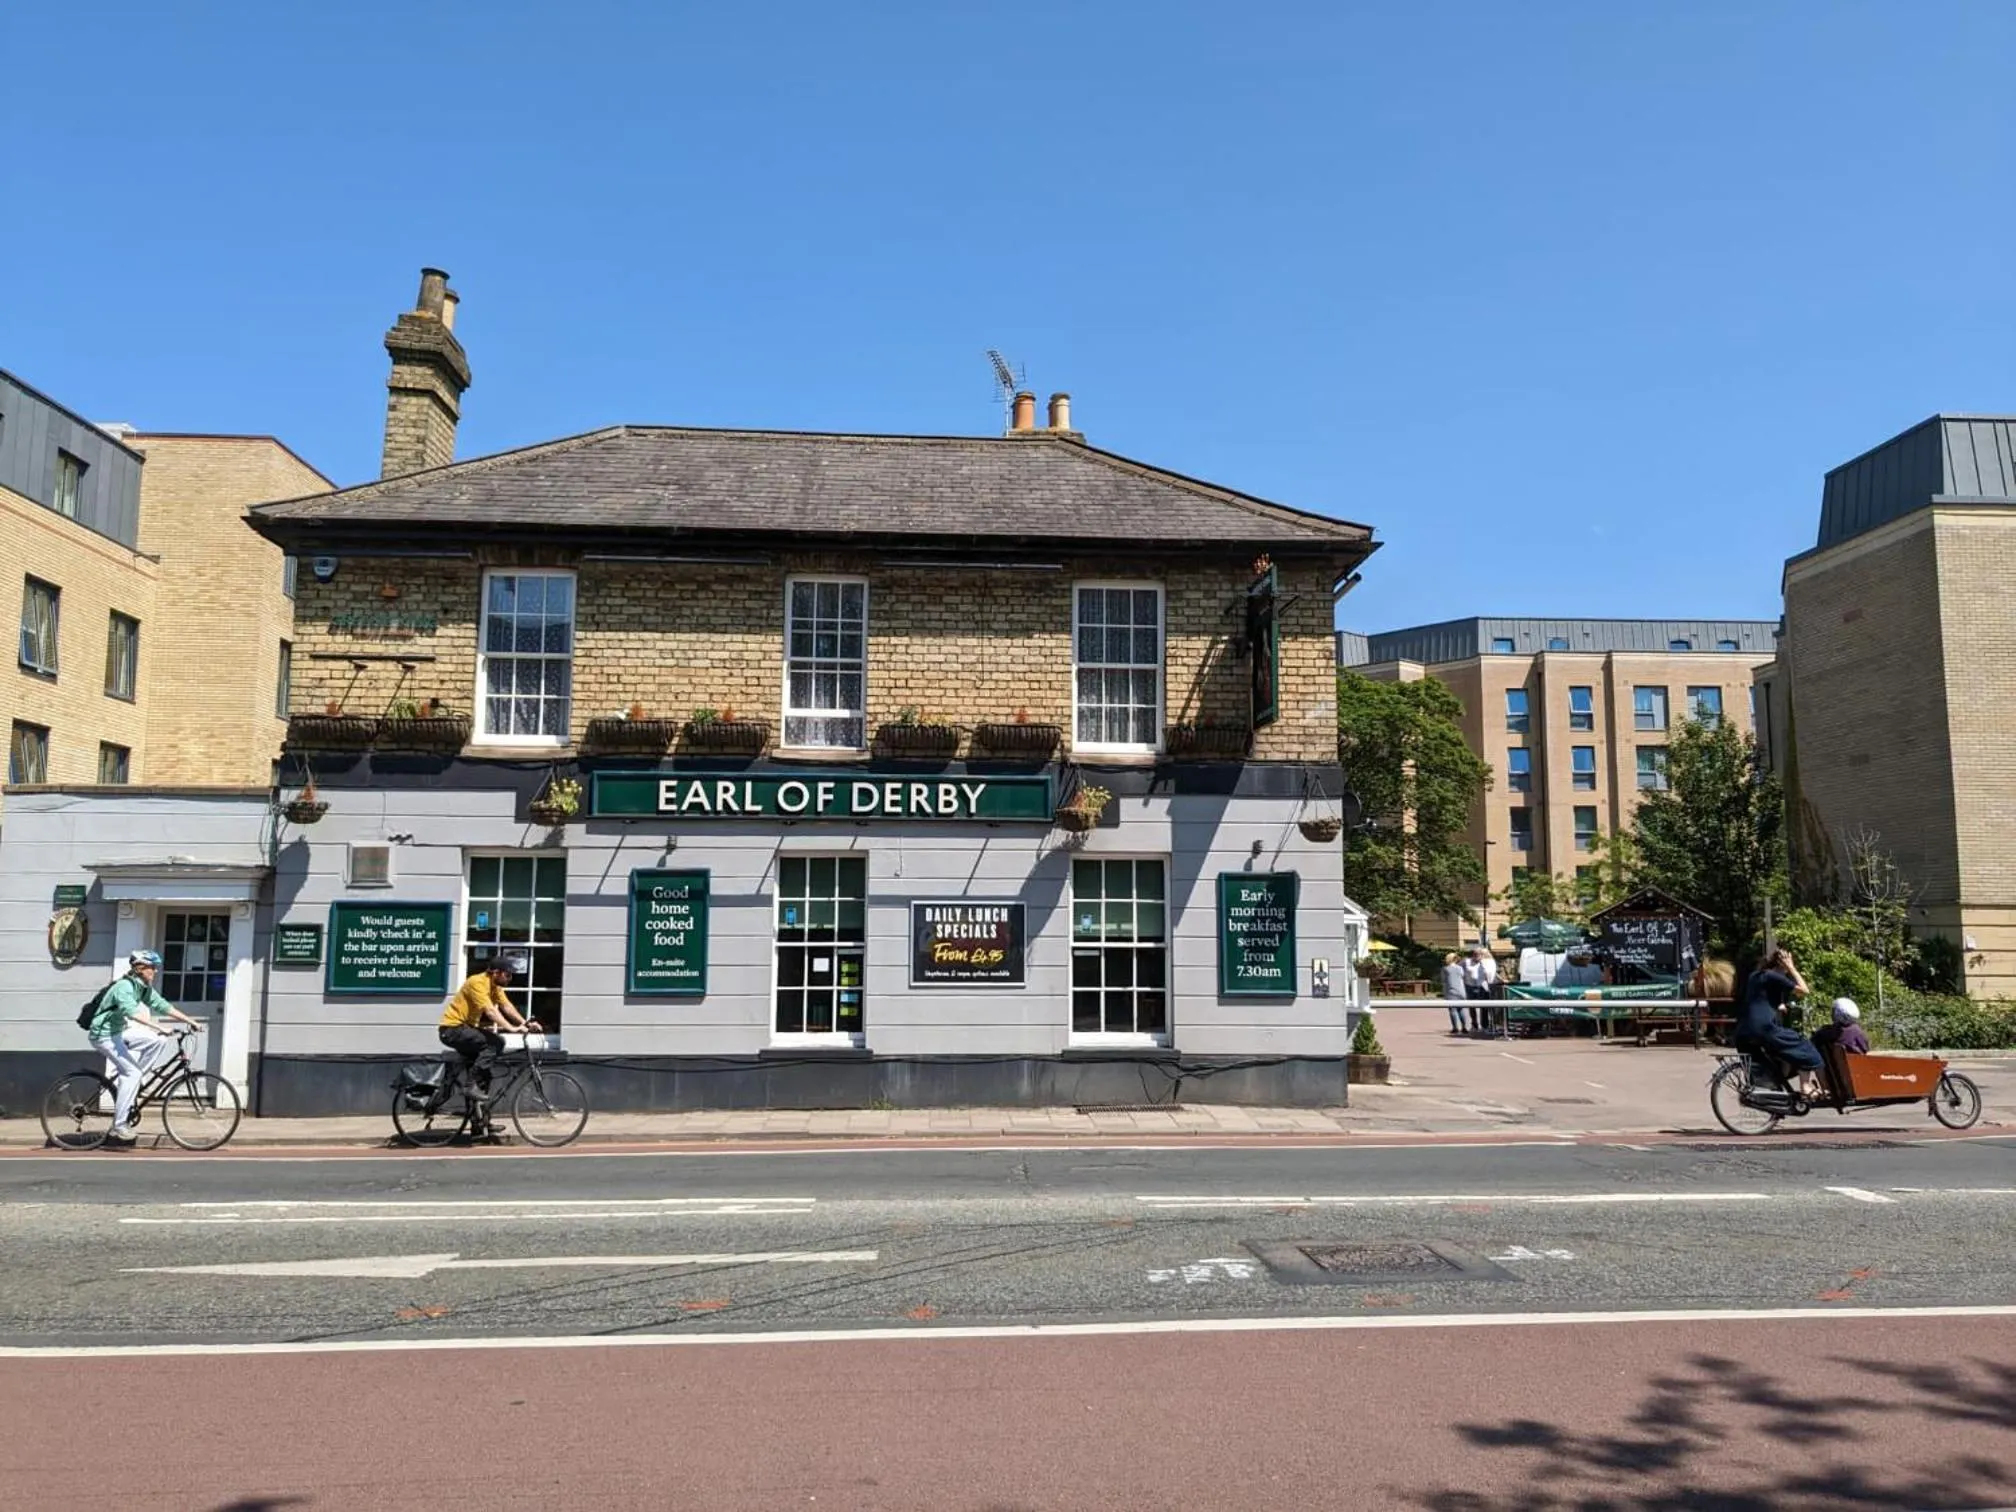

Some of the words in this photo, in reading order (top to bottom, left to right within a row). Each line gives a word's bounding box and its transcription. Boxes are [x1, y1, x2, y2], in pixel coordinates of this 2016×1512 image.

[657, 779, 763, 811] EARL
[777, 781, 835, 813] OF
[851, 782, 987, 814] DERBY
[652, 885, 689, 898] Good
[1240, 889, 1276, 904] Early
[651, 901, 690, 915] home
[925, 907, 962, 922] DAILY
[968, 907, 1008, 922] LUNCH
[1230, 904, 1286, 919] morning
[360, 916, 393, 925] Would
[394, 918, 425, 928] guests
[645, 917, 694, 930] cooked
[1228, 919, 1288, 932] breakfast
[347, 928, 378, 941] kindly
[426, 930, 437, 939] at
[936, 924, 997, 939] SPECIALS
[653, 932, 684, 946] food
[1237, 934, 1280, 947] served
[344, 941, 360, 952] the
[361, 942, 378, 952] bar
[379, 944, 405, 954] upon
[406, 942, 439, 952] arrival
[934, 942, 968, 963] From
[341, 956, 351, 965] to
[353, 956, 388, 965] receive
[389, 955, 413, 965] their
[415, 955, 438, 967] keys
[1243, 949, 1275, 962] from
[651, 958, 686, 967] En-suite
[358, 968, 376, 978] and
[378, 968, 422, 978] welcome
[636, 969, 700, 977] accommodation
[1236, 965, 1282, 977] 7.30am
